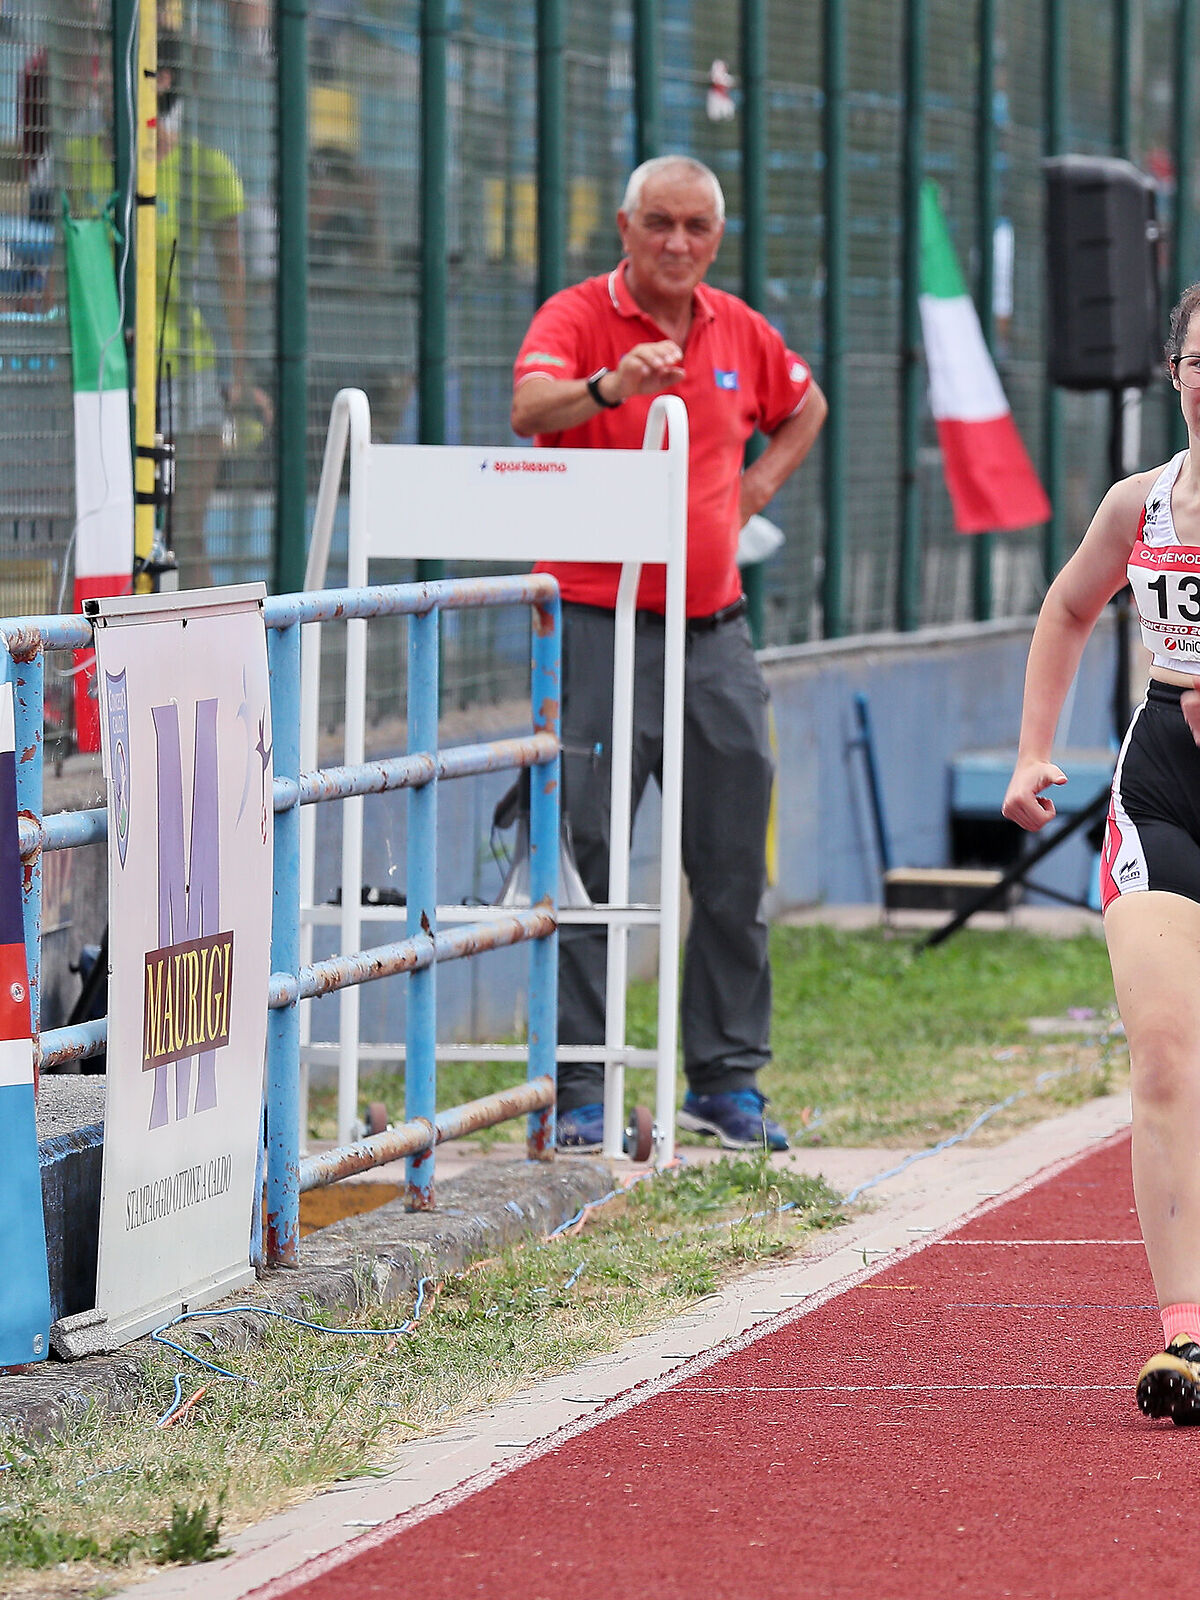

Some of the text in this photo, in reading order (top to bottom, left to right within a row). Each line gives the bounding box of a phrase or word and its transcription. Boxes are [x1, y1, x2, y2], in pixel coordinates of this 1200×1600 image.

[145, 943, 231, 1061] MAURIGI
[126, 1176, 172, 1231] STAMPAGGIO
[173, 1165, 201, 1213] OTTONE
[208, 1153, 231, 1198] CALDO
